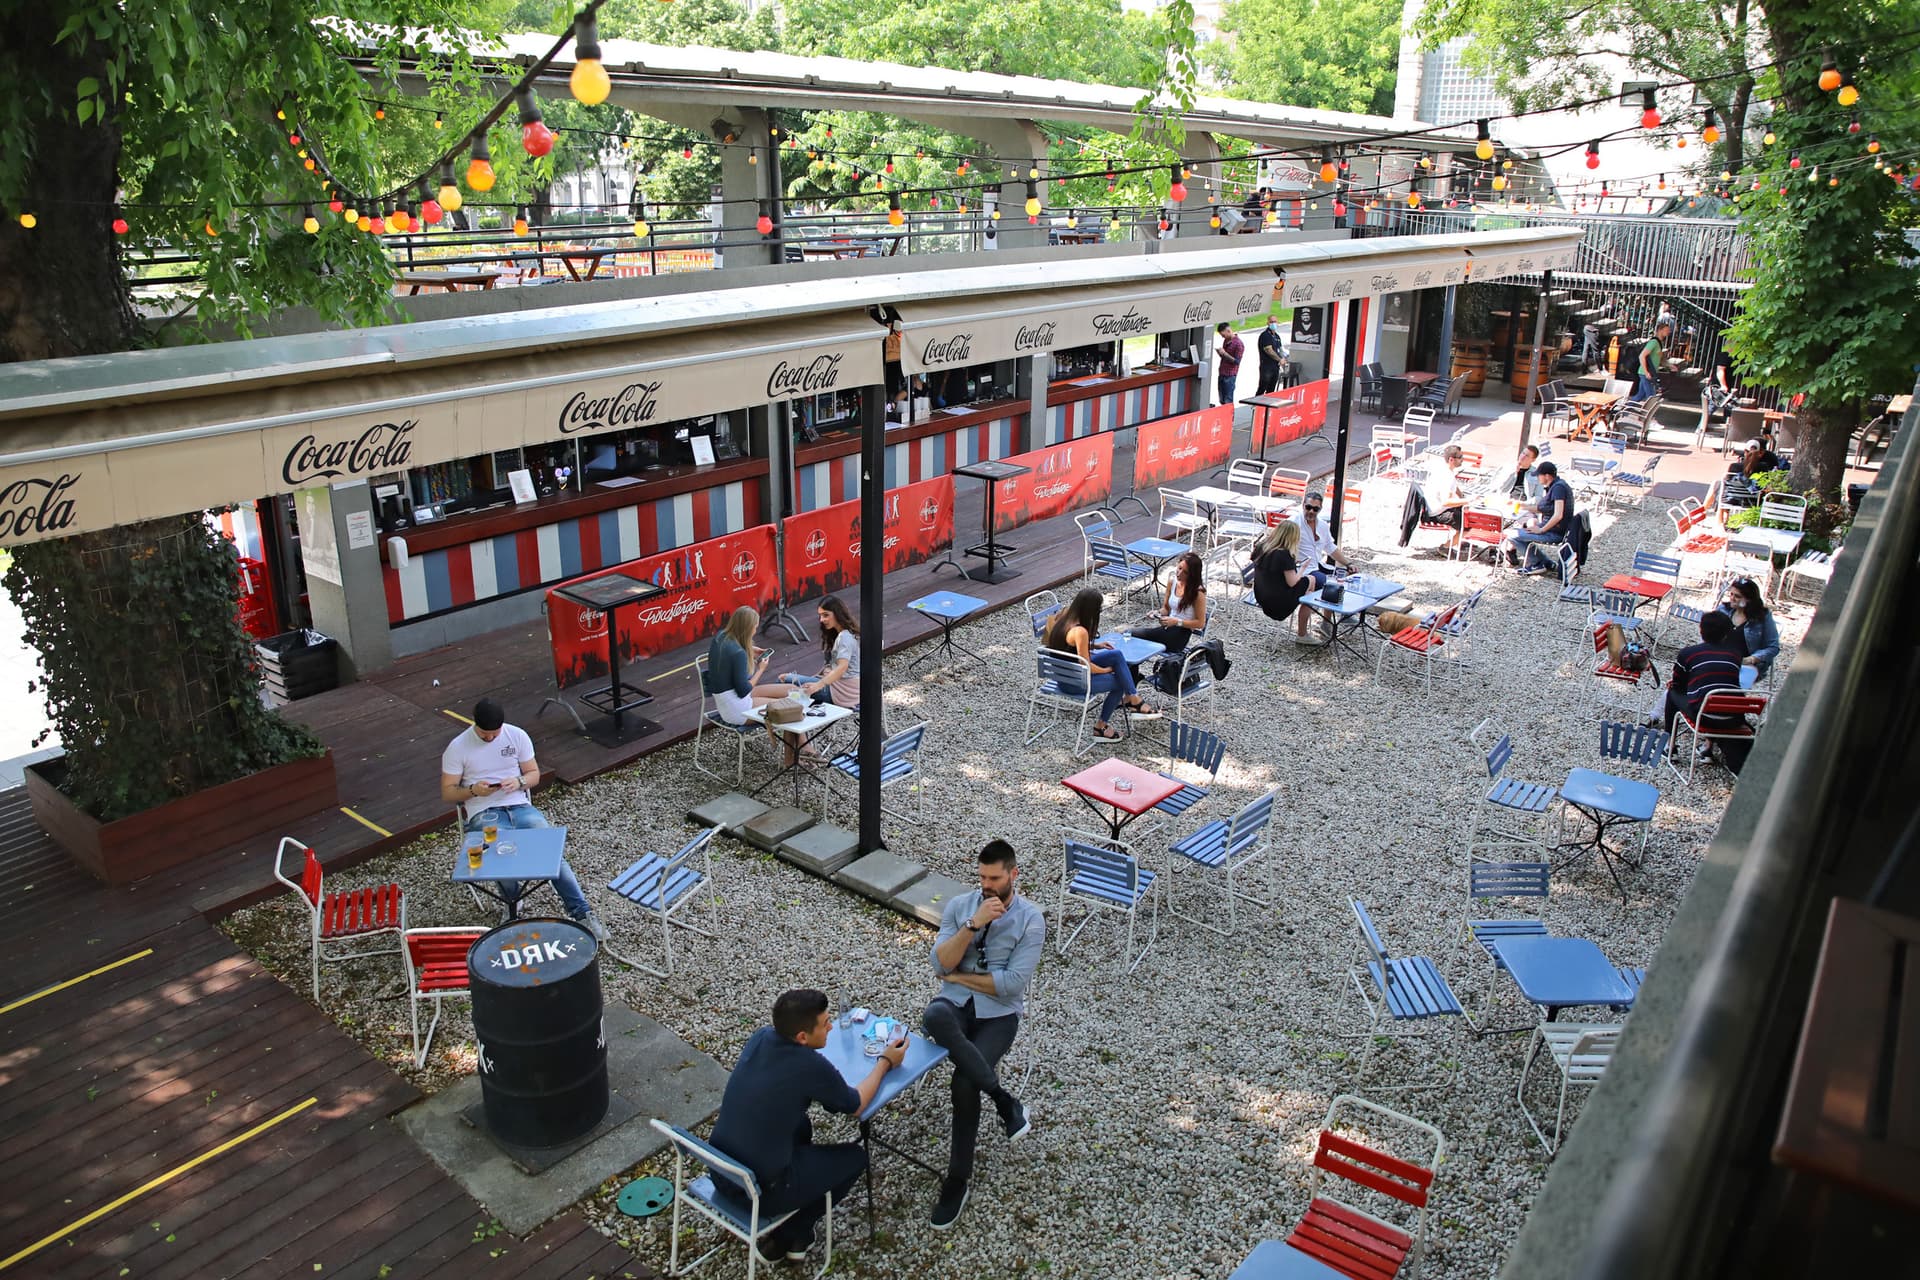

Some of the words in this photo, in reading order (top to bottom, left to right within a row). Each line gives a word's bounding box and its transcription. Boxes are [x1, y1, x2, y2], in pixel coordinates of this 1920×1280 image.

[922, 334, 973, 366] Coca-Cola
[1015, 322, 1057, 352] Coca-Cola
[767, 353, 844, 398] Coca-Cola
[558, 381, 663, 434] Coca-Cola
[282, 419, 420, 485] Coca-Cola
